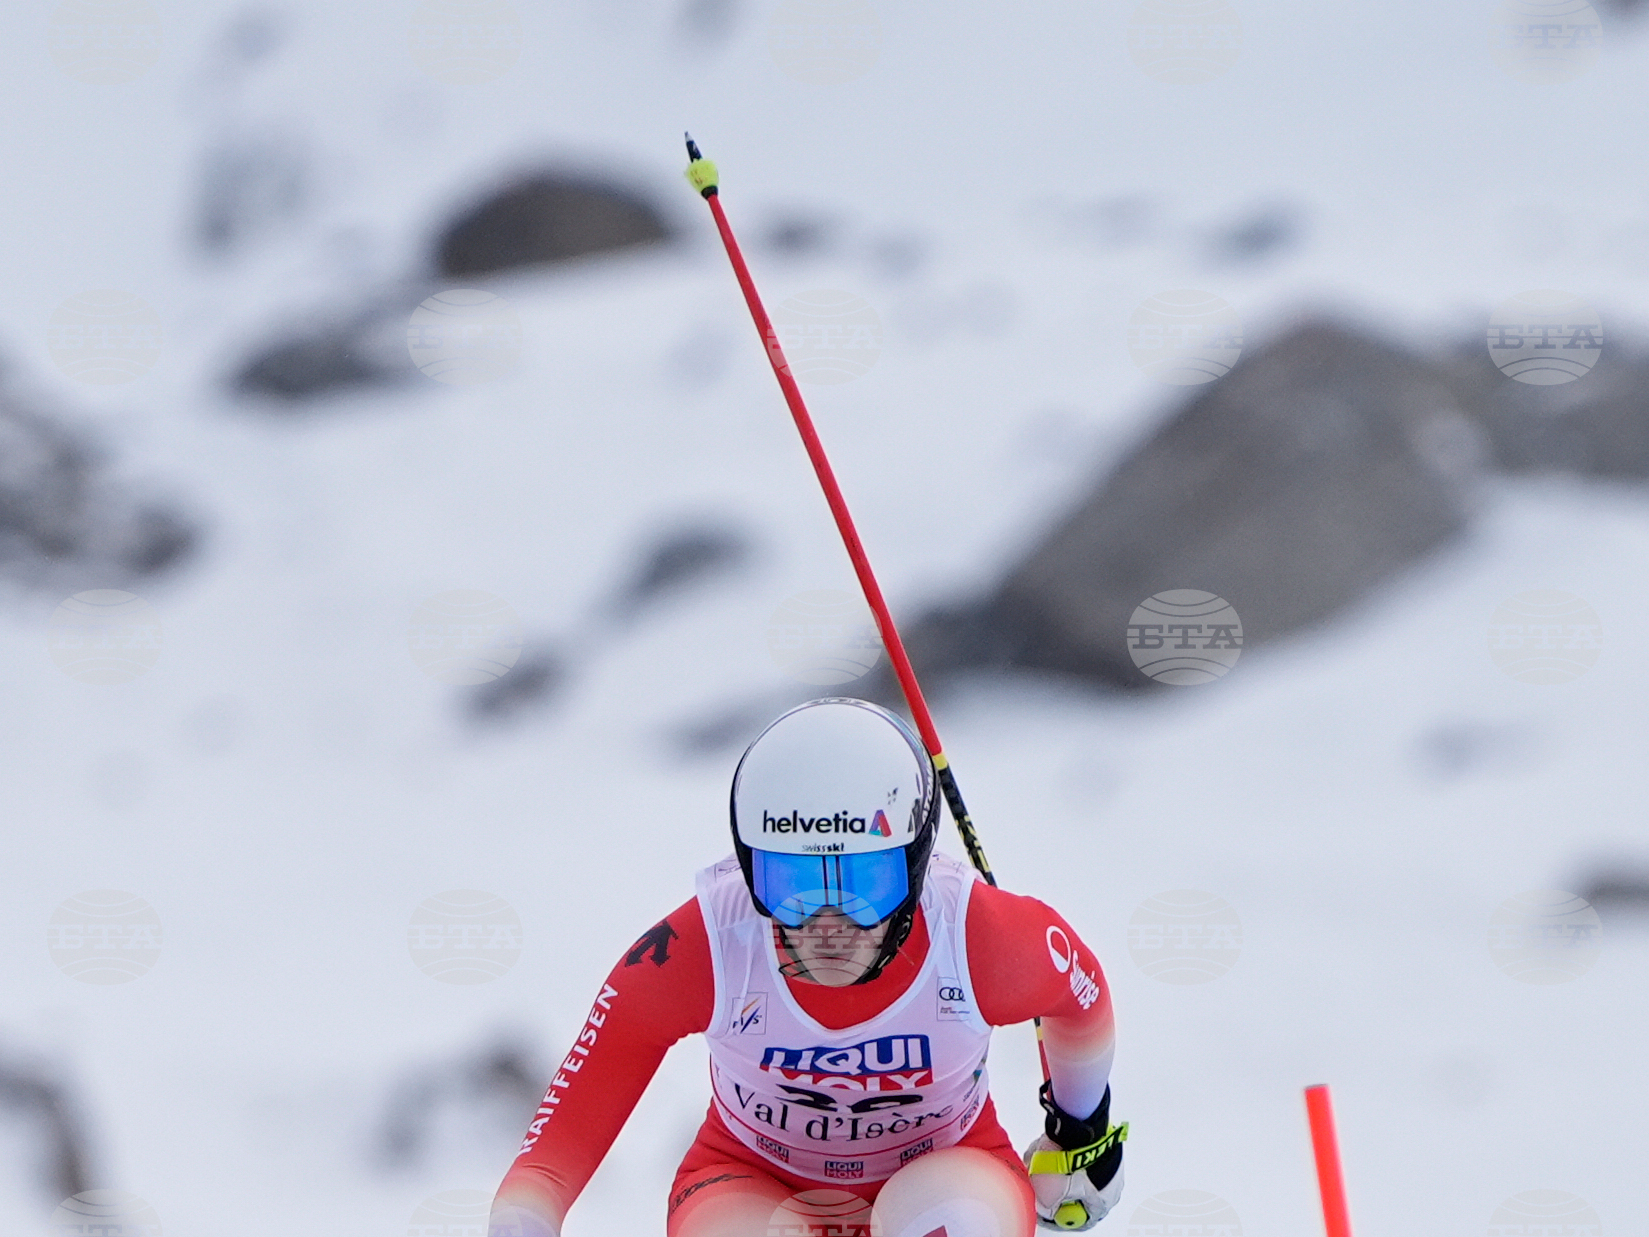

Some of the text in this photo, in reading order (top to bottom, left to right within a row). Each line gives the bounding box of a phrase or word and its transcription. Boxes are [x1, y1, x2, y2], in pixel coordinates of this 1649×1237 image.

[763, 810, 866, 833] helvetia
[519, 983, 618, 1157] RAIFFEISEN
[768, 1037, 924, 1075] LIQUI
[735, 1083, 789, 1132] Val
[827, 1161, 862, 1172] LIQUI
[827, 1170, 862, 1179] MOLY
